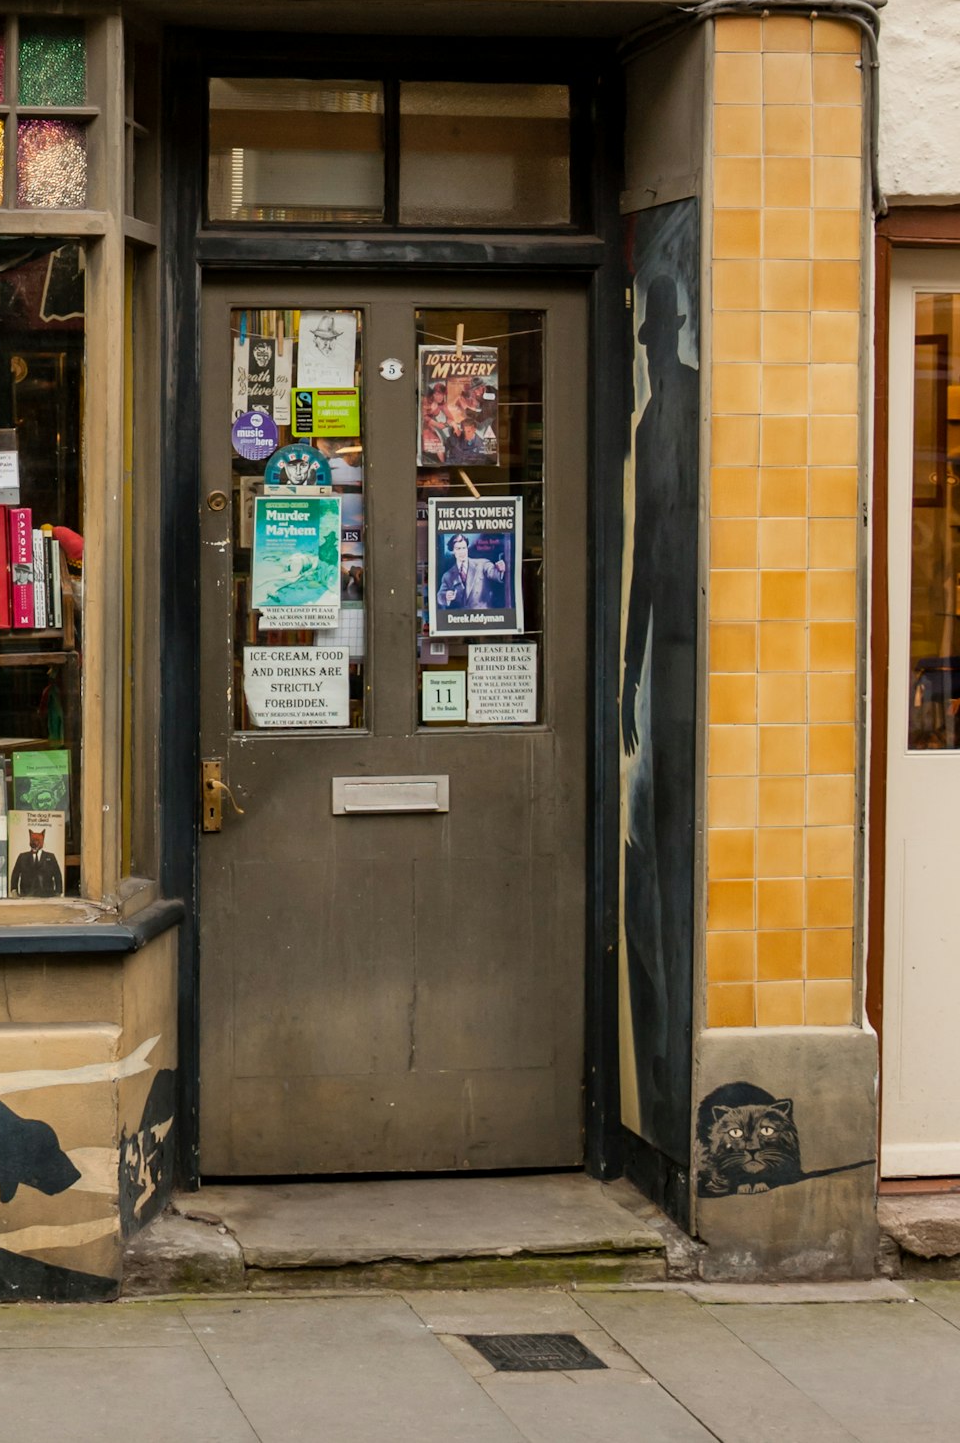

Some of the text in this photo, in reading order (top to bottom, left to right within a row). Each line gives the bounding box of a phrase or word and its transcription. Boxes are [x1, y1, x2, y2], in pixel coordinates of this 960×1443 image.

[426, 354, 440, 365] 10
[237, 366, 271, 383] Death
[389, 364, 396, 375] 5
[431, 363, 496, 378] MYSTERY
[238, 382, 286, 400] Delivery
[237, 428, 264, 438] music
[266, 510, 310, 521] Murder
[438, 506, 514, 518] THE CUSTOMER'S
[437, 519, 514, 531] ALWAYS WRONG
[266, 525, 316, 537] Mayhem
[19, 512, 27, 562] CAPONE
[21, 616, 29, 624] M
[447, 614, 504, 624] Derek Addyman
[250, 651, 344, 661] ICE-CREAM, FOOD
[251, 667, 342, 676] AND DRINKS ARE
[270, 682, 323, 692] STRICTLY
[436, 688, 452, 703] 11
[265, 699, 328, 708] FORBIDDEN.
